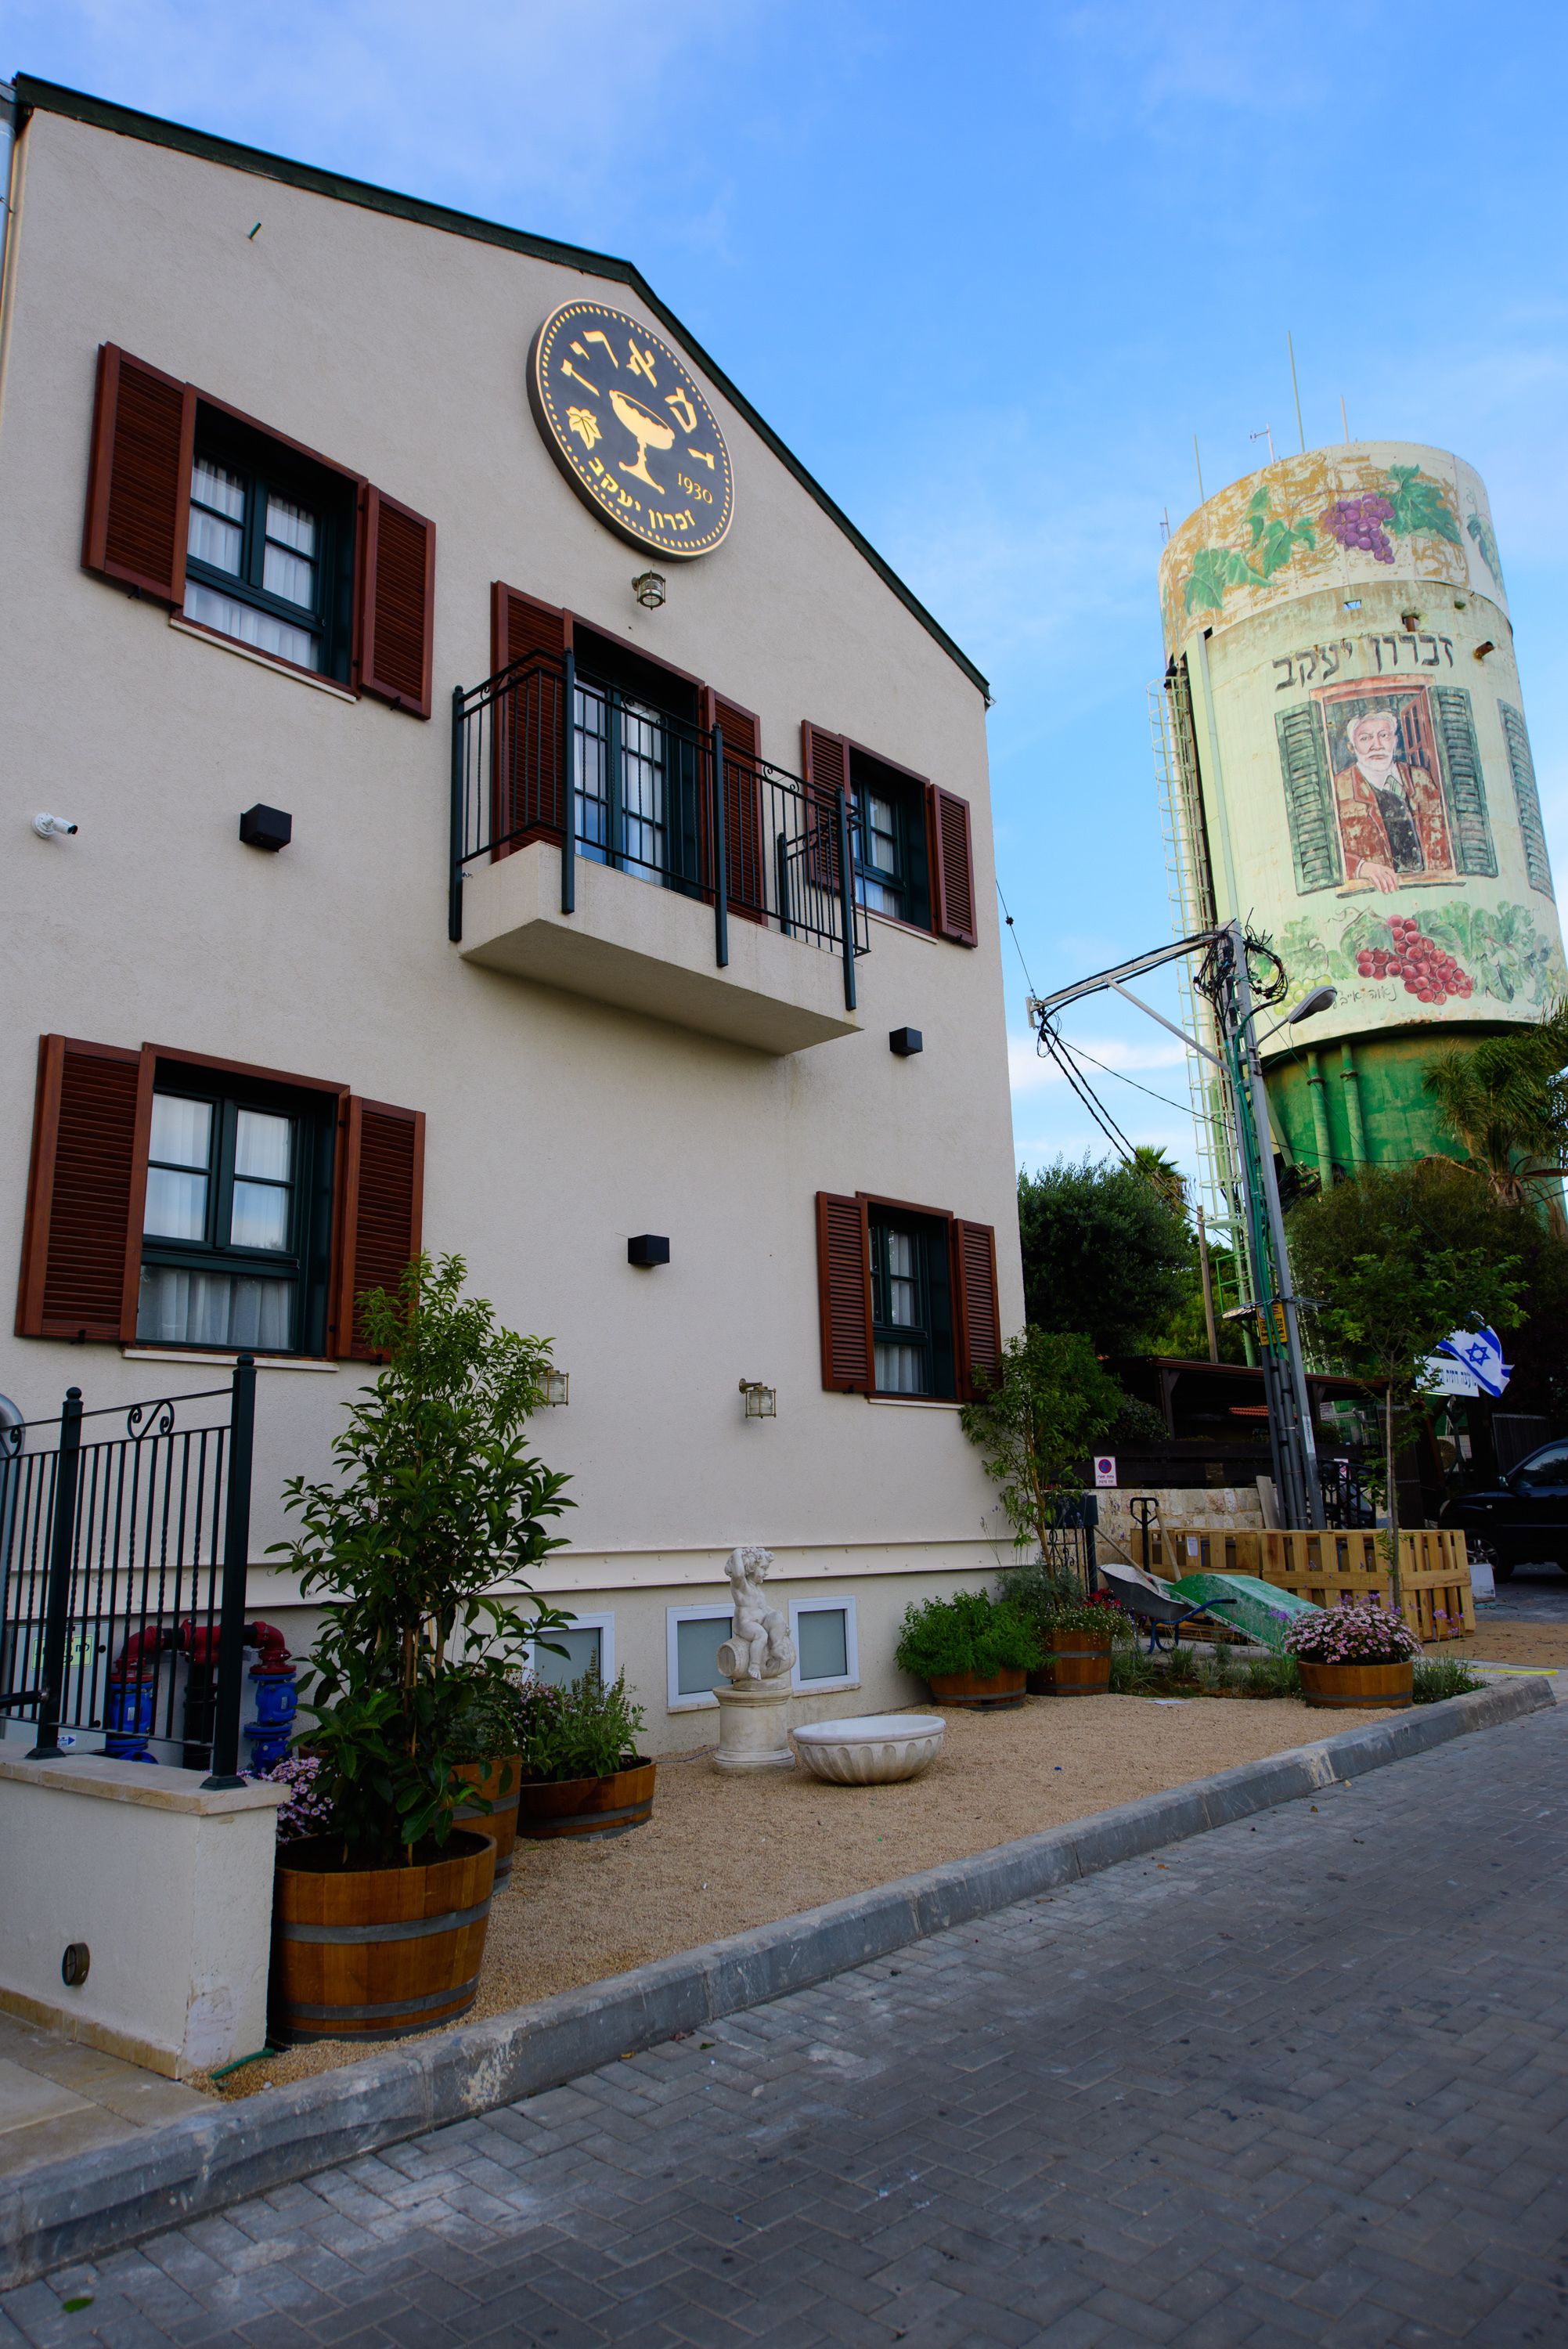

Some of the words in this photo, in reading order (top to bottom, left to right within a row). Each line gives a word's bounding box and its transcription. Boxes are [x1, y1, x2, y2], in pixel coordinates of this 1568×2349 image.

[588, 456, 641, 511] יעקב
[676, 471, 713, 504] 1930
[648, 508, 696, 531] זכרון
[1272, 640, 1354, 692] יעקב
[1371, 633, 1454, 674] זכרון
